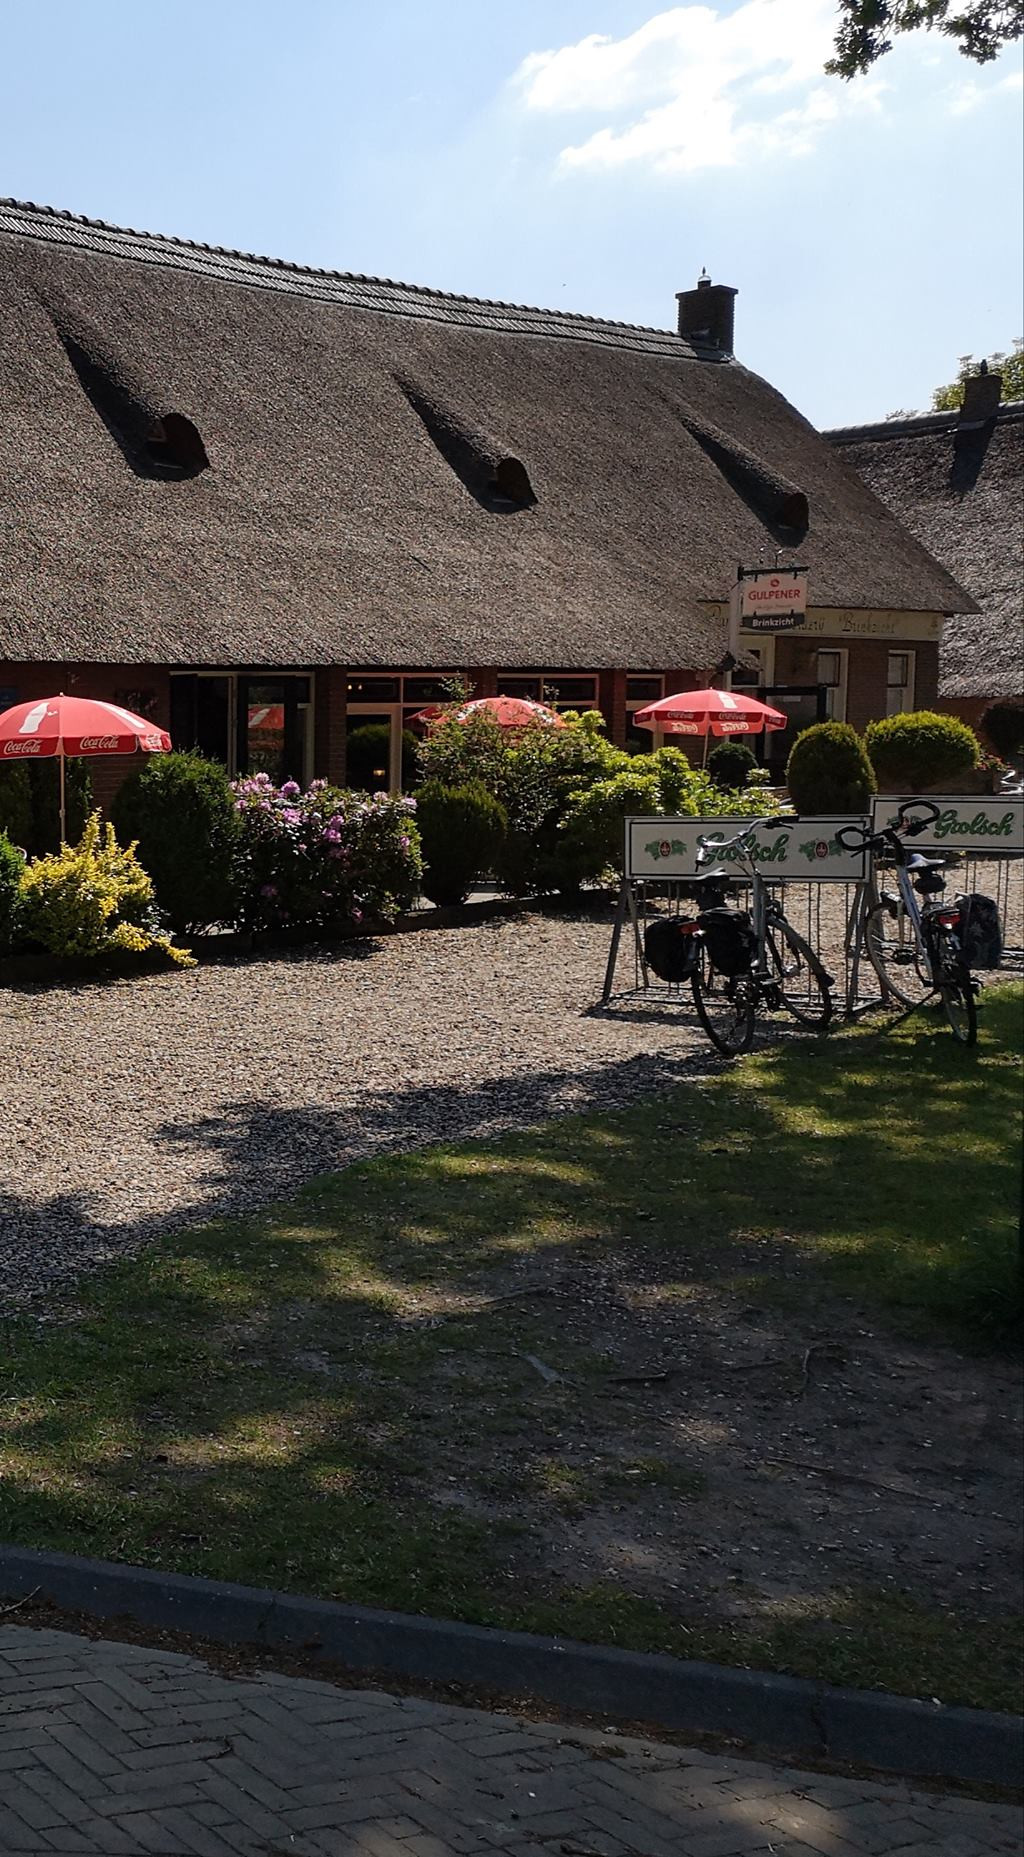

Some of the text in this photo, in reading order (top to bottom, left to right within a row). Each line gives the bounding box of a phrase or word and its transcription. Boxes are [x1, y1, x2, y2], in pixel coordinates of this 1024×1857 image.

[748, 589, 801, 600] GULPENER
[752, 617, 795, 627] Brinkzicht
[933, 809, 1015, 839] Grolsch
